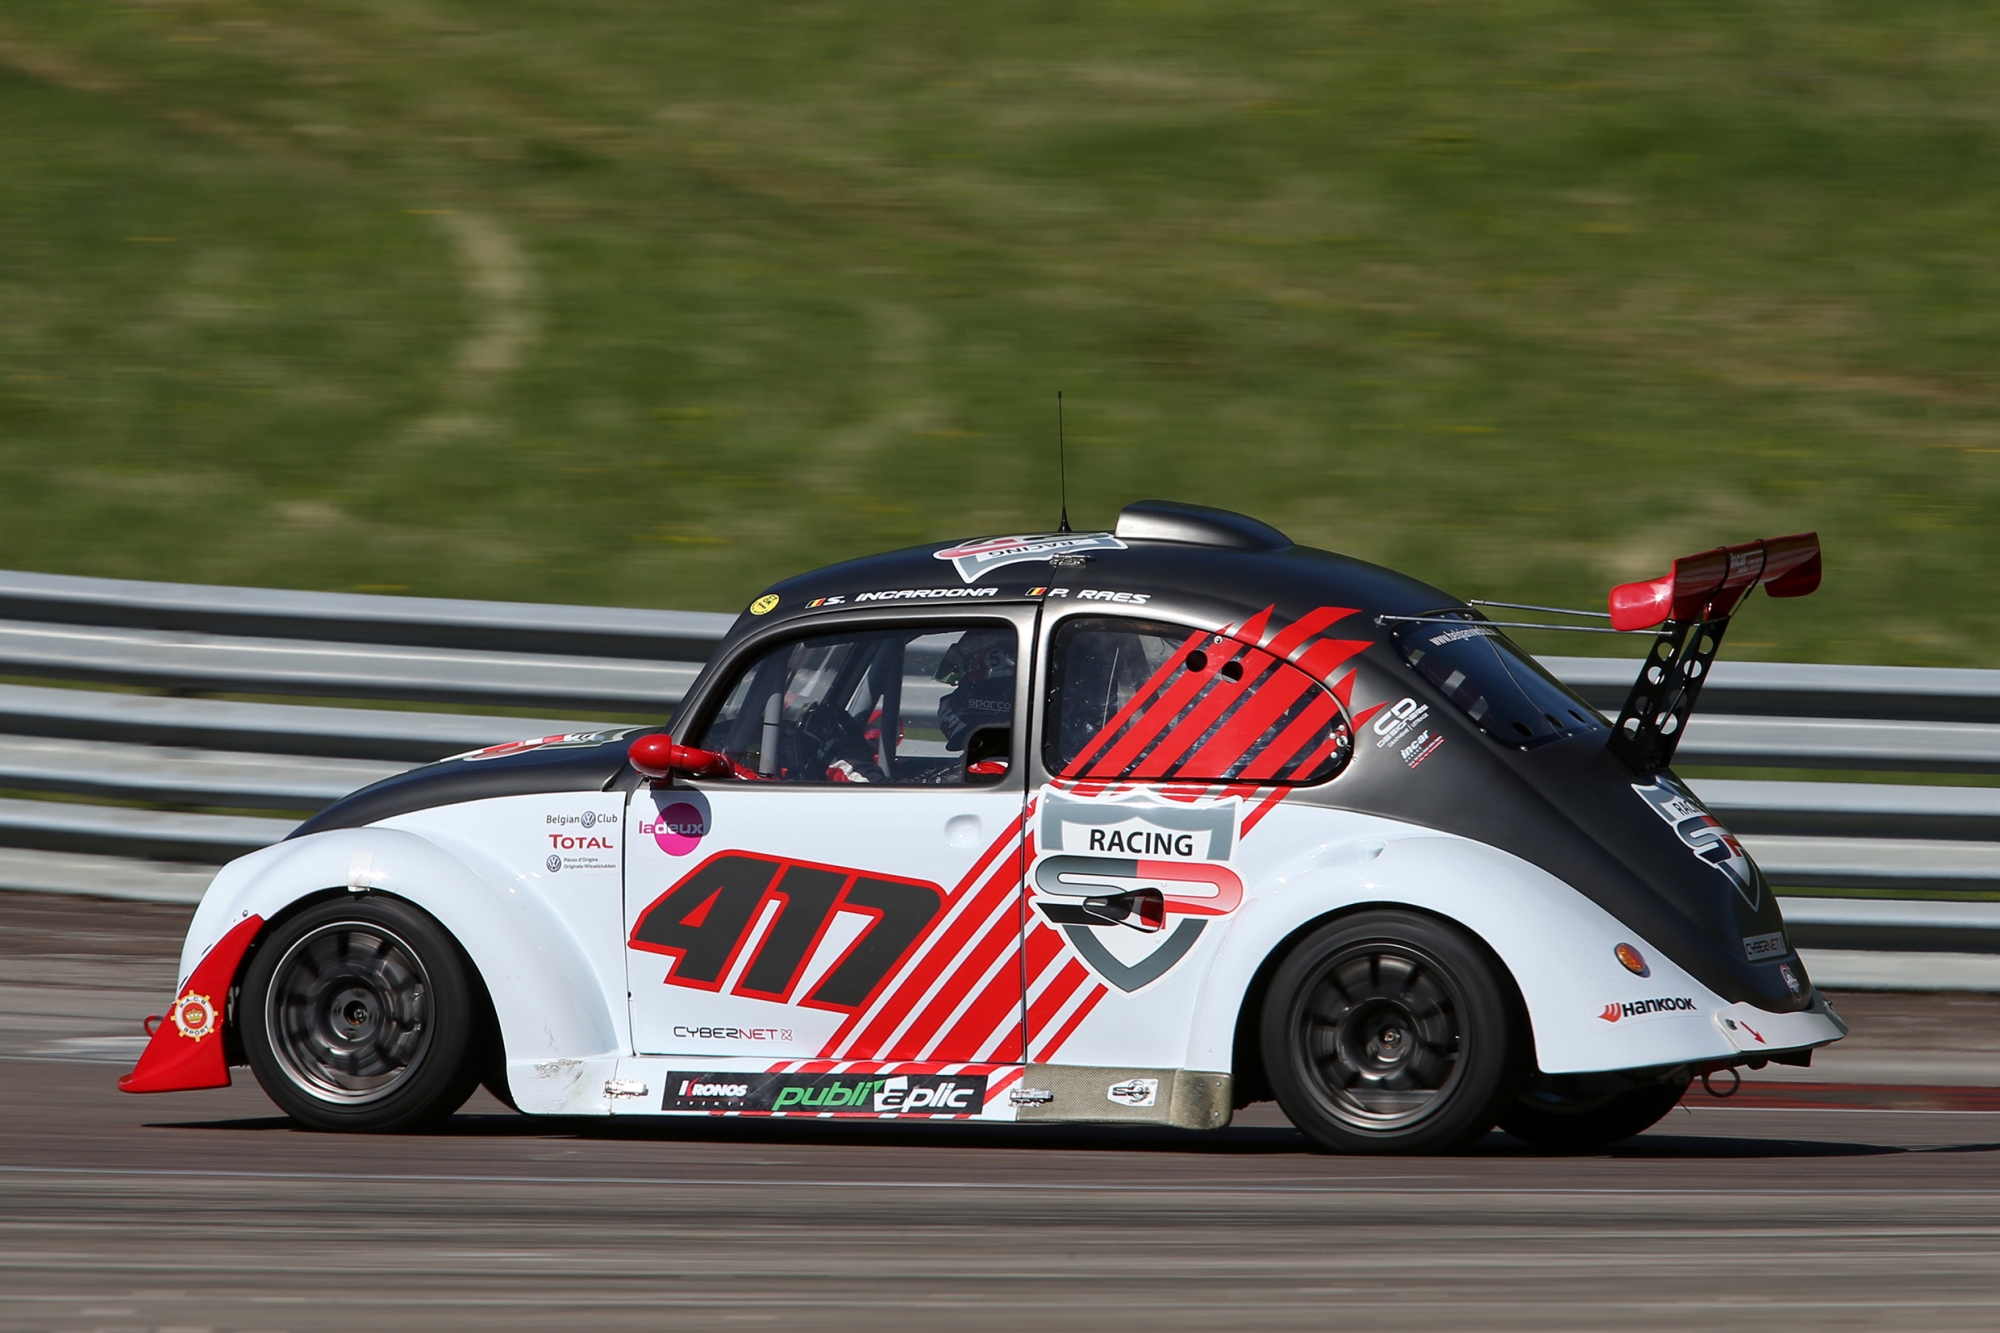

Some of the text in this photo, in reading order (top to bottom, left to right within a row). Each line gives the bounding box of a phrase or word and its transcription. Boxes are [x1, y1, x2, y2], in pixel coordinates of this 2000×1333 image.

[822, 587, 999, 606] S. INCARDONA
[1047, 587, 1152, 604] P. RAES
[990, 651, 1000, 667] 5
[967, 698, 1012, 711] sparco
[546, 814, 580, 826] Belgian
[597, 813, 618, 823] Club
[548, 834, 614, 850] TOTAL
[1089, 829, 1194, 857] RACING
[628, 849, 948, 1014] 417
[183, 1024, 209, 1036] SPORT
[678, 1076, 749, 1097] KRONOS
